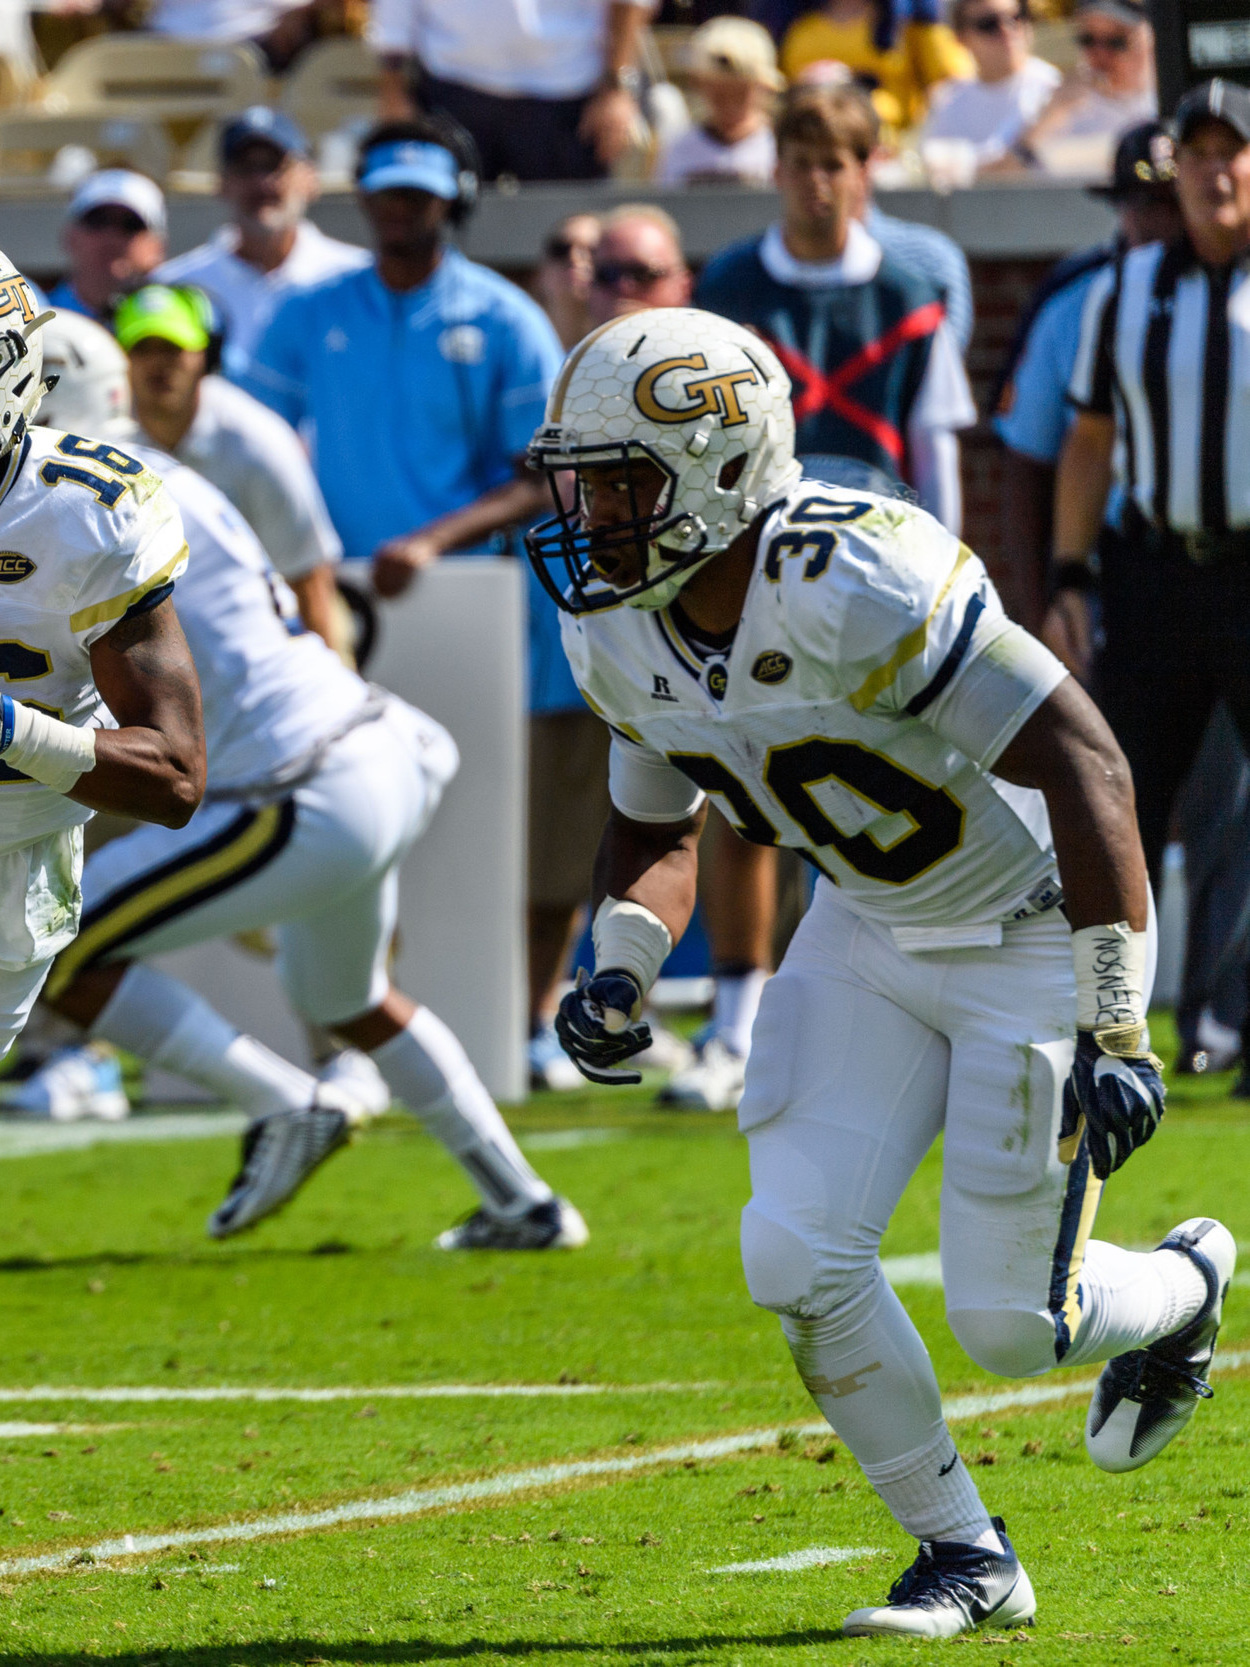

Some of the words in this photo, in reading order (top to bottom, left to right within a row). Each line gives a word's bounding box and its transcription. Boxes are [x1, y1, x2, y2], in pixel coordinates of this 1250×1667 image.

[633, 352, 759, 429] GT
[38, 432, 147, 511] 16
[764, 496, 875, 584] 30
[1091, 937, 1138, 1027] BENSON
